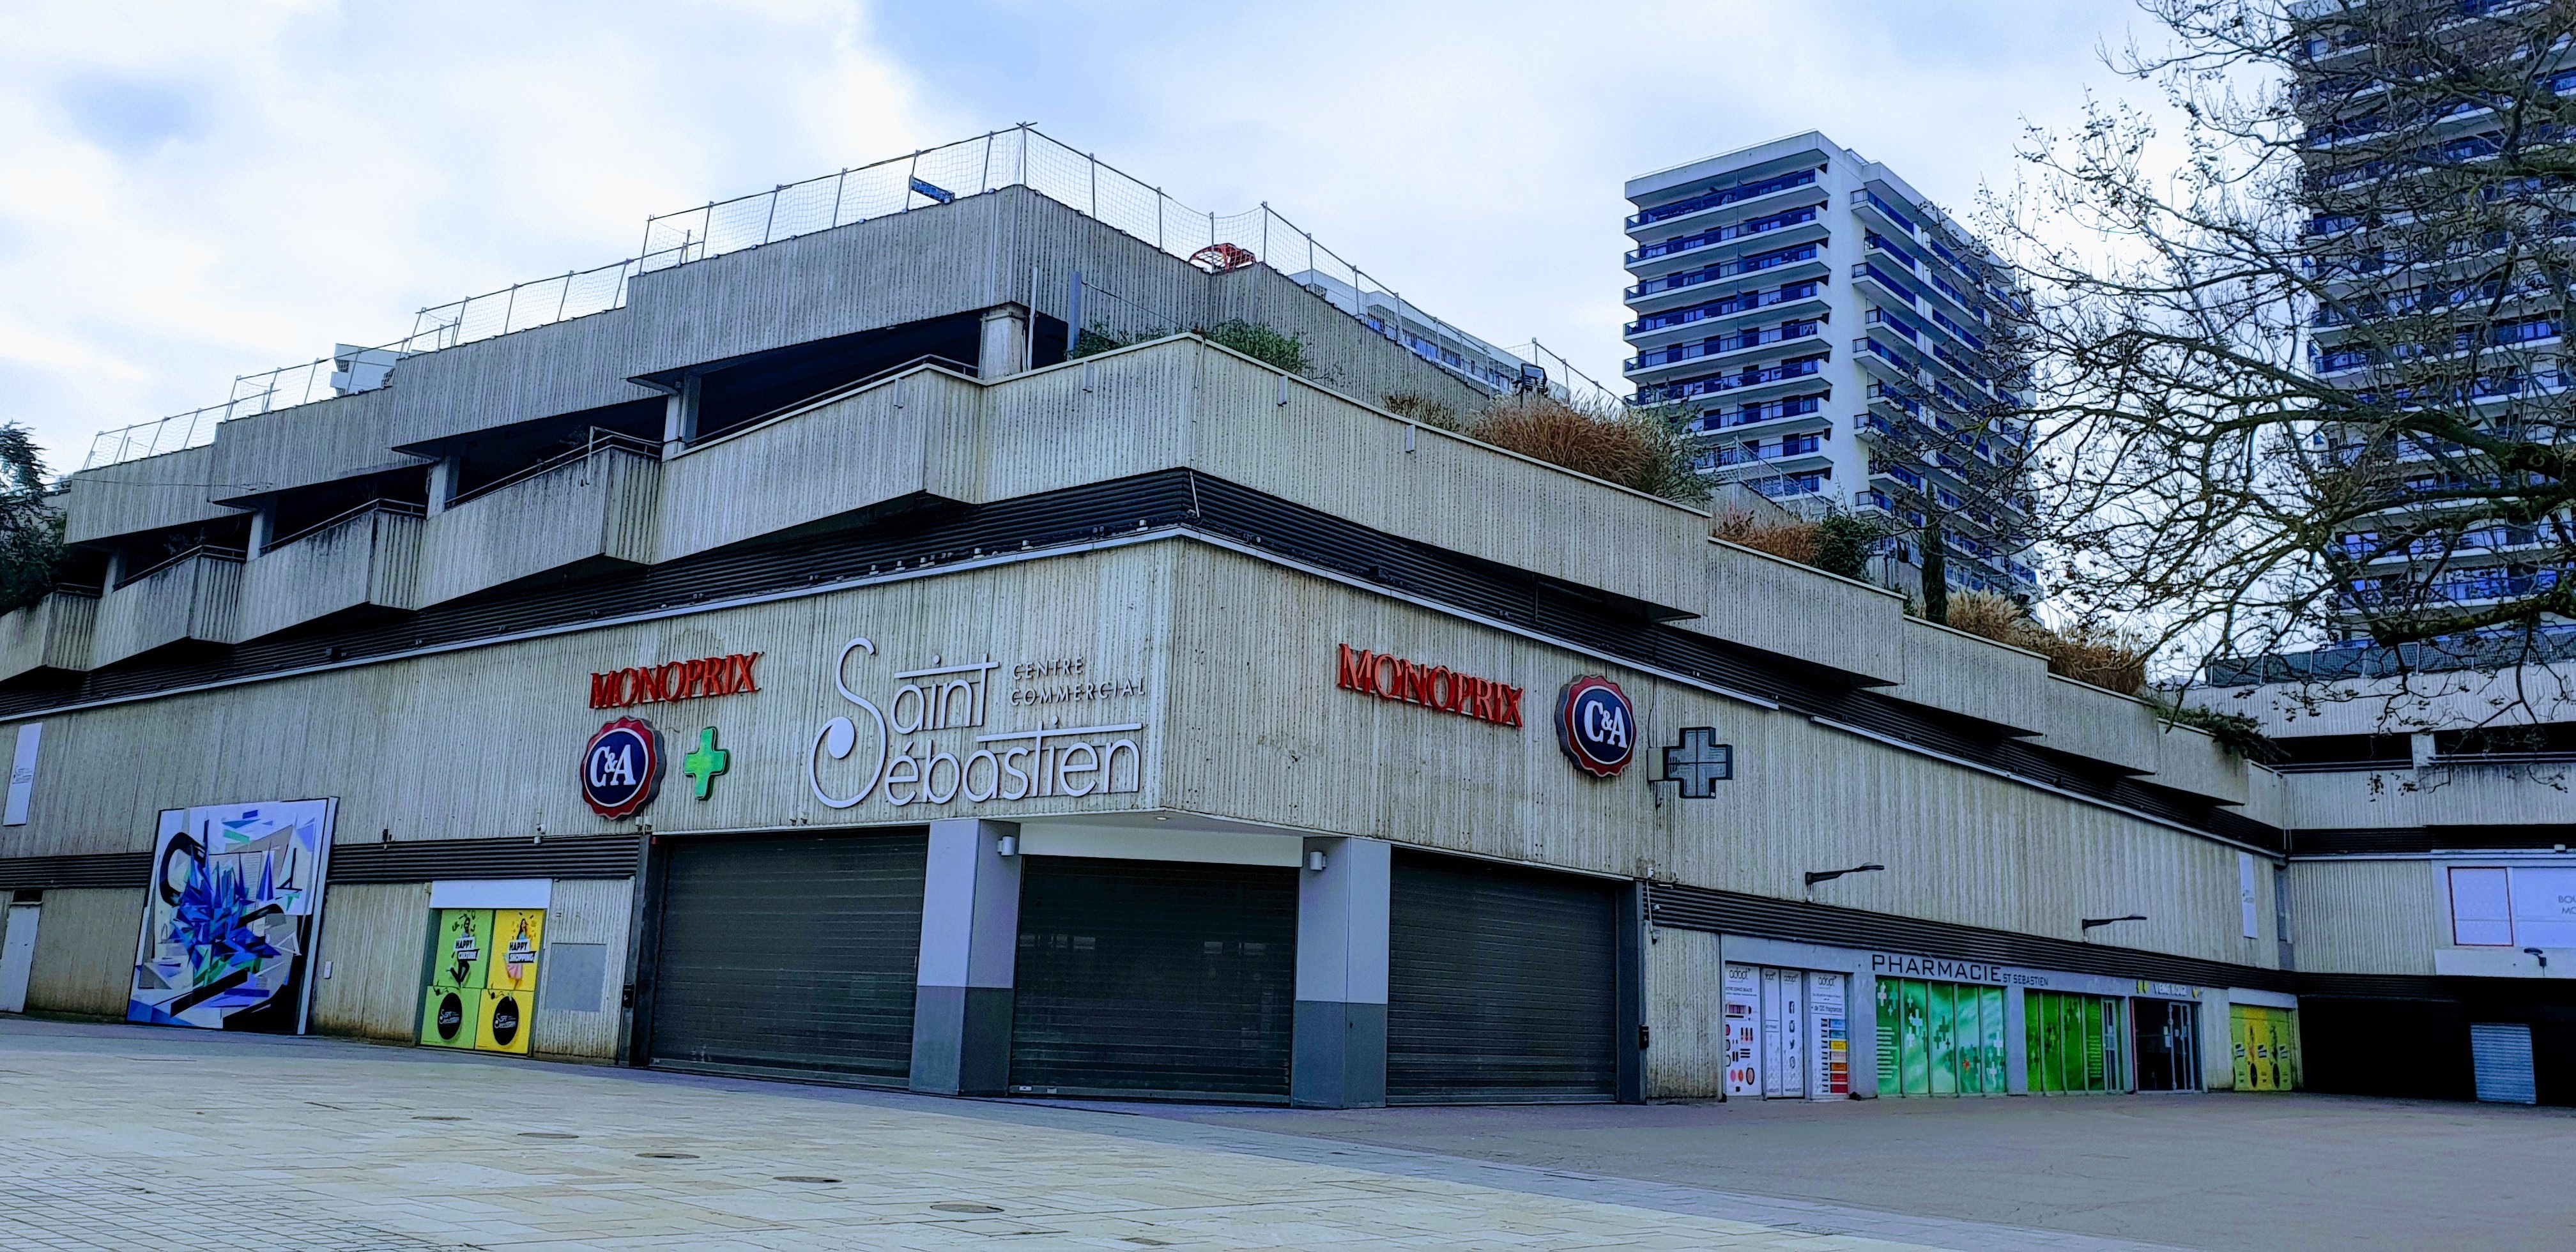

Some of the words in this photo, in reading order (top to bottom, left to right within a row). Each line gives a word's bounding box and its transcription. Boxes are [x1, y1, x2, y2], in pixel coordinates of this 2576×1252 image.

[589, 652, 759, 709] MONOPRIX
[1011, 655, 1084, 681] CENTRE
[1009, 676, 1146, 706] COMMERCIAL
[1338, 643, 1524, 728] MONOPRIX
[1583, 700, 1628, 749] C&A
[590, 744, 637, 788] C&A
[455, 939, 473, 949] HAPPY
[509, 941, 528, 951] HAPPY
[1872, 954, 2002, 982] PHARMACIE
[2002, 973, 2012, 984] ST
